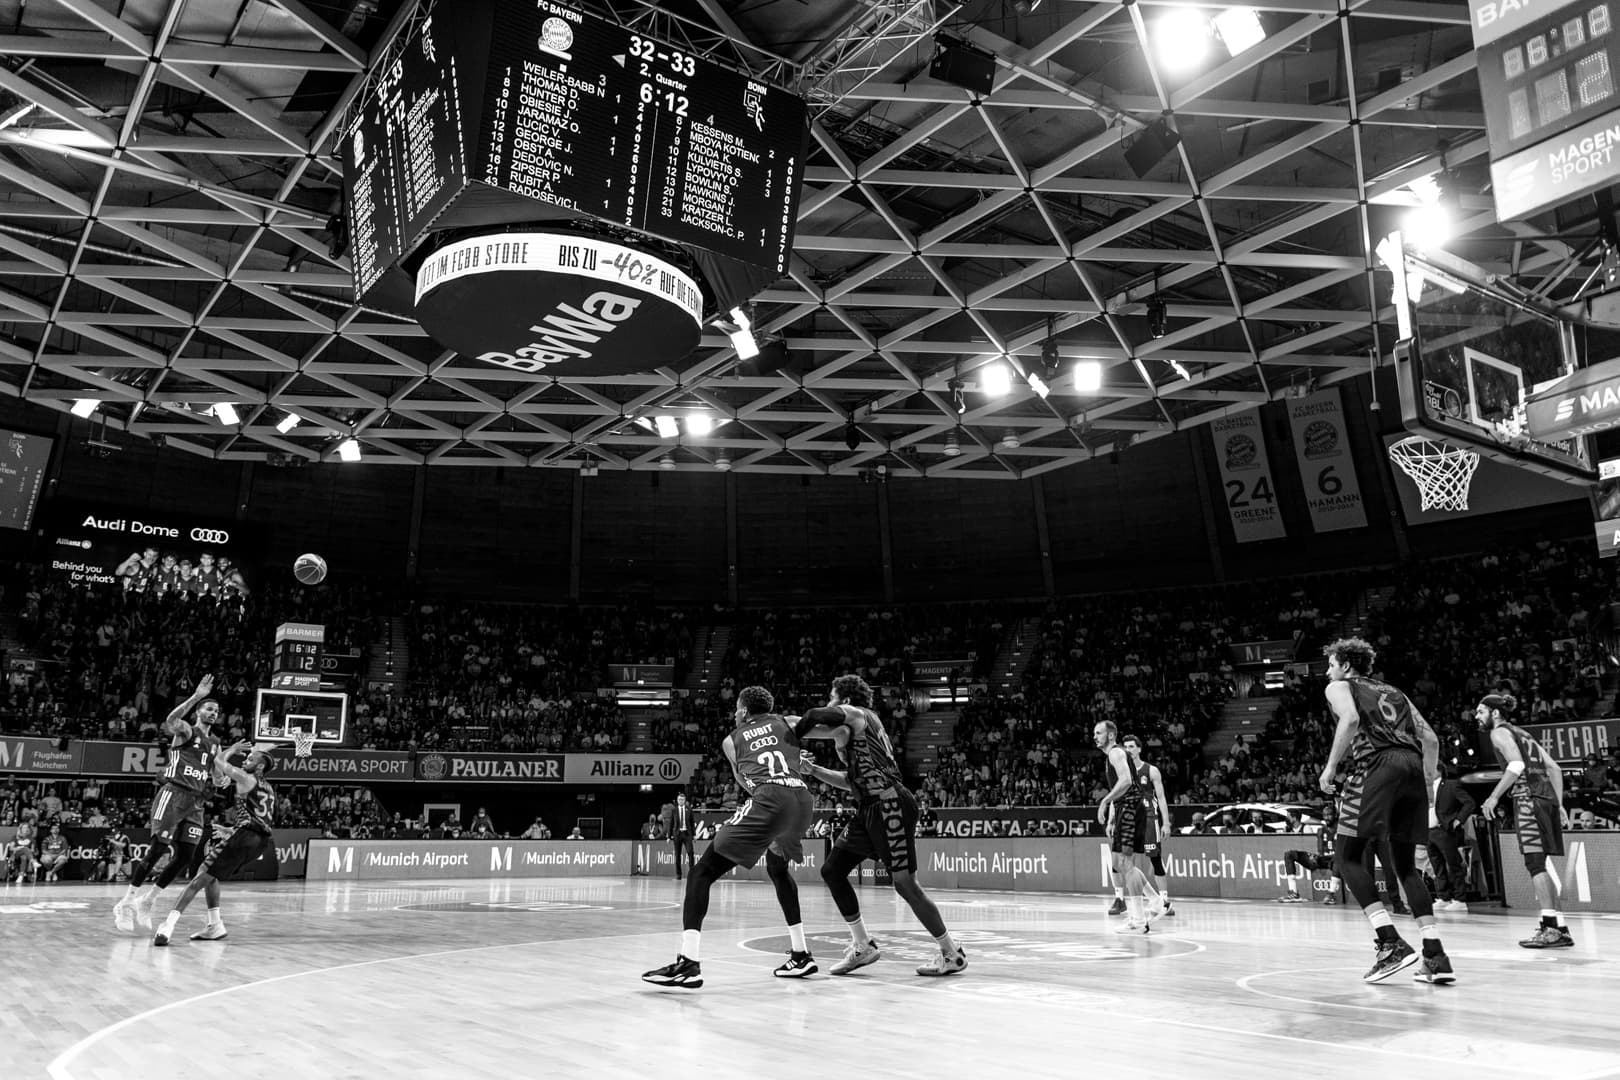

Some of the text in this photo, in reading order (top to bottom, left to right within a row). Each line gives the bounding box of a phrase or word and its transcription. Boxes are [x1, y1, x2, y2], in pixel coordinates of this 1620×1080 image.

[537, 0, 583, 24] FC BAYERN
[628, 36, 696, 77] 32-33
[378, 60, 403, 106] 32-33
[506, 67, 580, 100] 1 THOMAS D.
[524, 60, 605, 98] WEILER-BABB N
[598, 74, 607, 86] 3
[640, 63, 688, 92] 2. Quarter
[747, 81, 768, 95] BONN
[502, 88, 572, 120] 9 OBIESIE J.
[503, 77, 578, 111] 8 HUNTER O.
[640, 83, 689, 117] 6:12
[386, 100, 406, 137] 6:12
[495, 109, 560, 138] 11 LUCIC V.
[496, 98, 581, 134] 10 JARAMAZ O.
[706, 114, 714, 126] 4
[492, 131, 555, 159] 13 OBST A.
[493, 120, 573, 154] 12 GEORGE J.
[676, 116, 745, 148] 6 KESSENS M.
[676, 126, 682, 135] 7
[690, 131, 722, 150] MBOYA
[490, 142, 574, 177] 14 DEDOVIC N.
[669, 145, 743, 178] 10 KULVIETIS S.
[674, 136, 731, 164] 9 TADDA K.
[486, 164, 554, 193] 21 RUBIT A.
[489, 153, 561, 184] 16 ZIPSER P.
[668, 156, 739, 187] 11 LYPOVYY O.
[1551, 145, 1614, 185] SPORT
[484, 176, 582, 212] 43 RADOSEVIC L.
[666, 166, 732, 195] 12 BOWLIN S.
[666, 176, 735, 207] 13 HAWKINS J.
[662, 196, 733, 227] 21 KRATZER L.
[663, 186, 733, 217] 20 MORGAN J.
[661, 206, 744, 241] 33 JACKSON-C. P.
[437, 254, 449, 280] IM
[452, 245, 480, 273] FCBB
[485, 242, 529, 266] STORE
[558, 244, 579, 269] BIS
[582, 248, 597, 271] ZU
[600, 252, 658, 285] -40%
[660, 270, 676, 296] AUF
[677, 278, 687, 304] DIE
[475, 291, 643, 373] BayWa
[1580, 386, 1620, 414] MA
[1226, 476, 1274, 508] 24
[1318, 466, 1343, 495] 6
[1234, 506, 1277, 519] GREENE
[1309, 494, 1361, 508] HAMANN
[82, 516, 180, 538] Audi Dome
[52, 560, 103, 574] Behind you
[70, 572, 116, 584] for what's
[300, 656, 314, 671] 12
[1378, 693, 1397, 722] 6
[742, 724, 773, 741] RUBIT
[32, 760, 68, 770] München
[33, 751, 73, 761] Flughafen
[122, 747, 167, 773] RE
[283, 758, 358, 774] MAGENTA
[360, 758, 409, 774] SPORT
[450, 758, 560, 779] PAULANER
[590, 760, 654, 777] Allianz
[757, 750, 791, 778] 21
[882, 800, 909, 872] BONN
[67, 846, 103, 860] idas
[275, 843, 307, 864] ayW
[328, 846, 616, 873] M Munich Airport M Munich Airport
[658, 850, 675, 865] Muni
[933, 852, 1049, 881] Munich Airport
